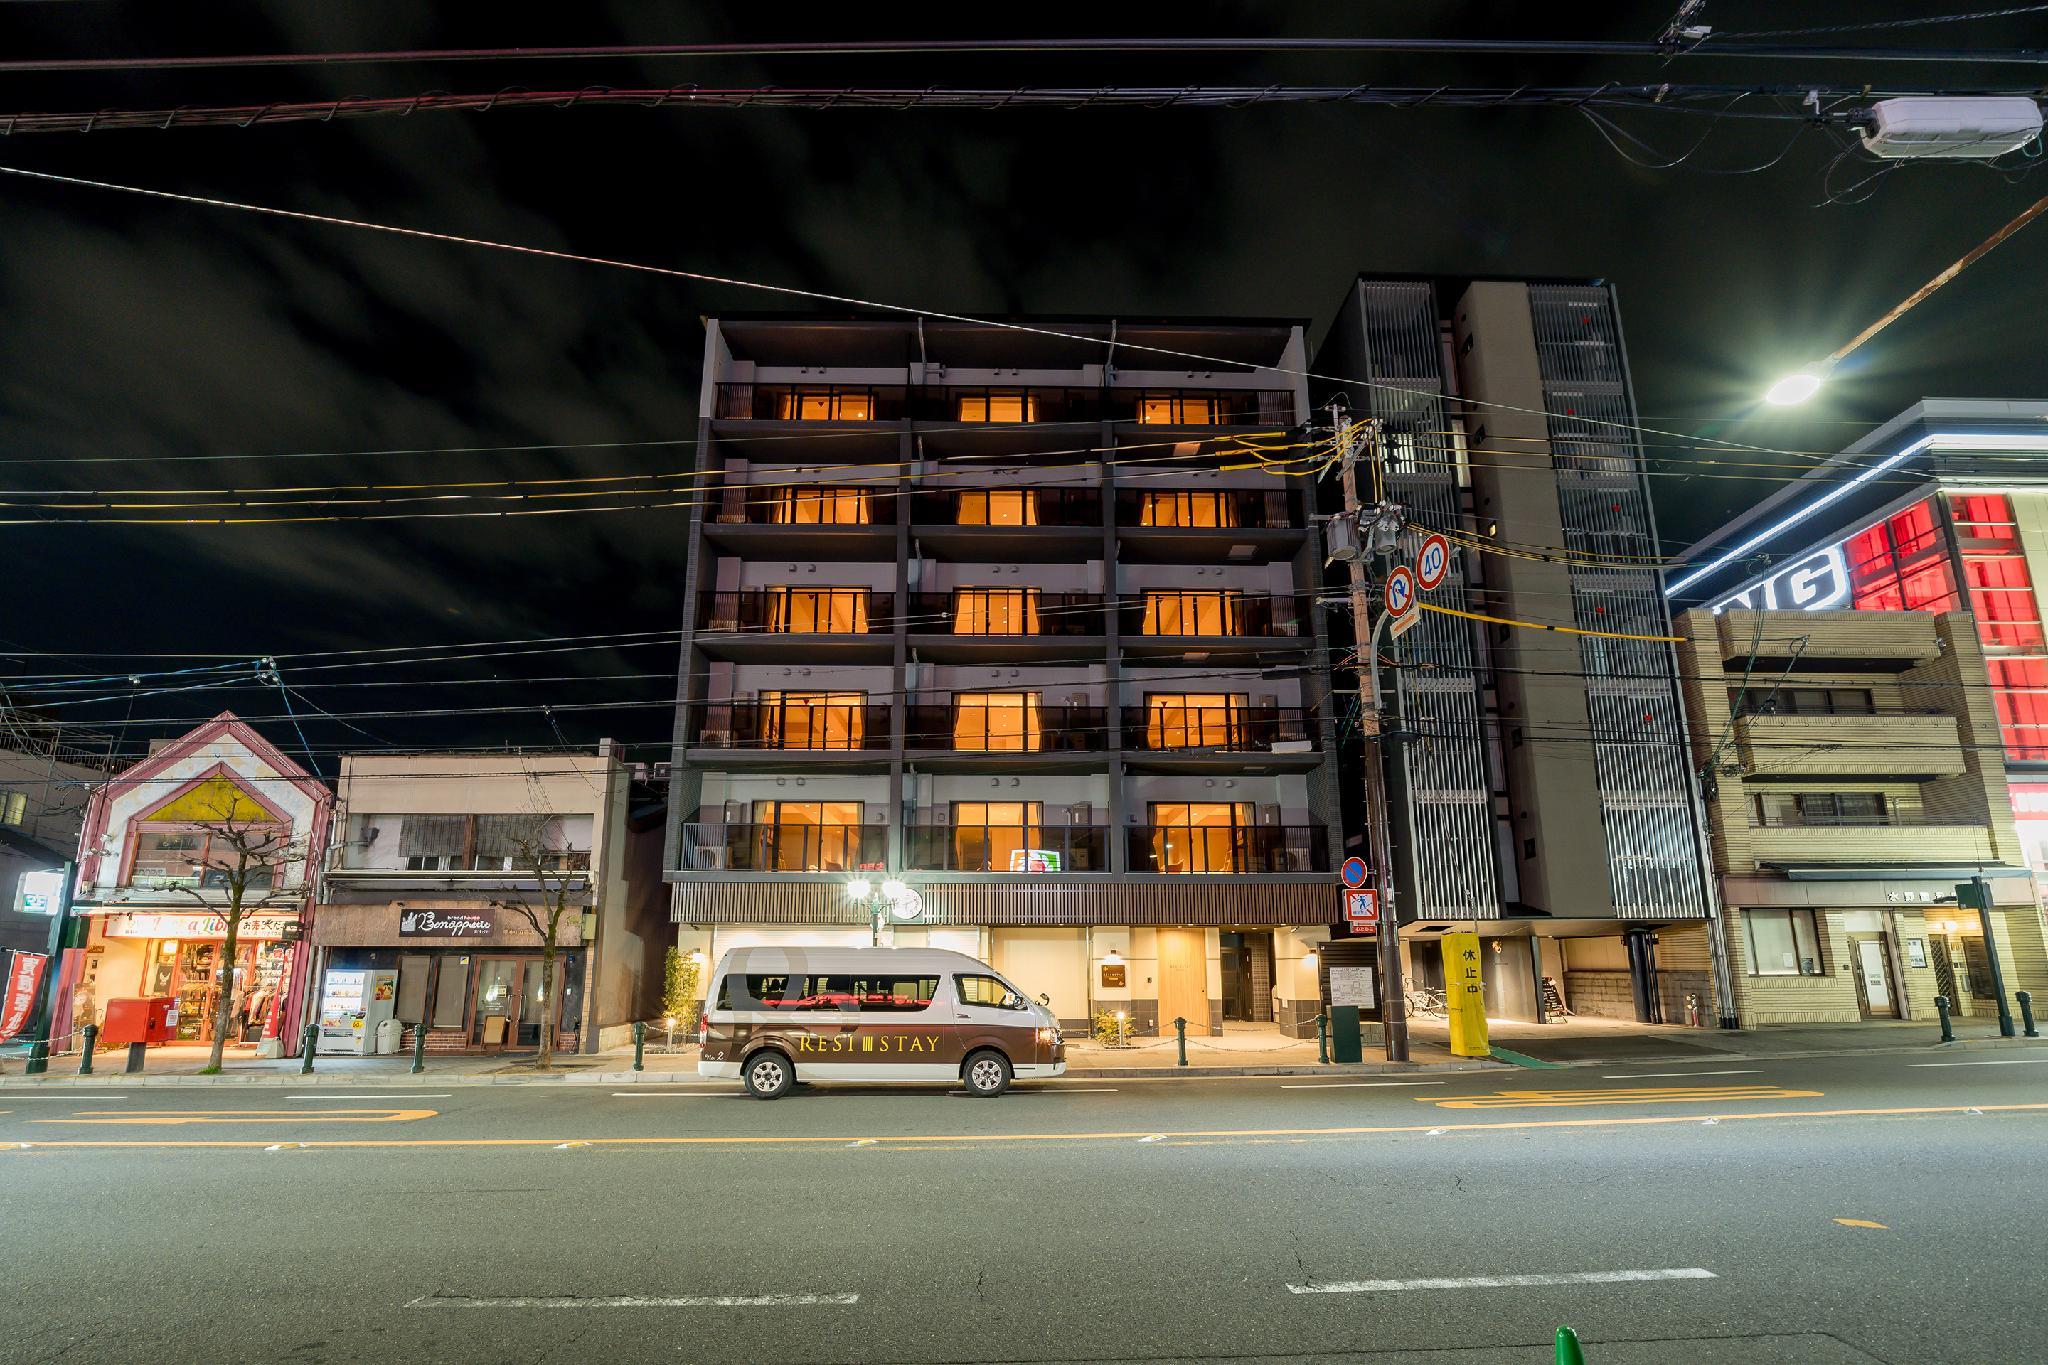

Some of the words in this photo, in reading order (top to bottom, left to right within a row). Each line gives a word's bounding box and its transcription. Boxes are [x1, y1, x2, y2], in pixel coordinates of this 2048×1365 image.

[1424, 547, 1442, 577] 40
[1463, 949, 1478, 995] 休止中
[799, 1035, 854, 1052] RESI
[879, 1035, 940, 1052] STAY
[716, 1051, 724, 1061] 2
